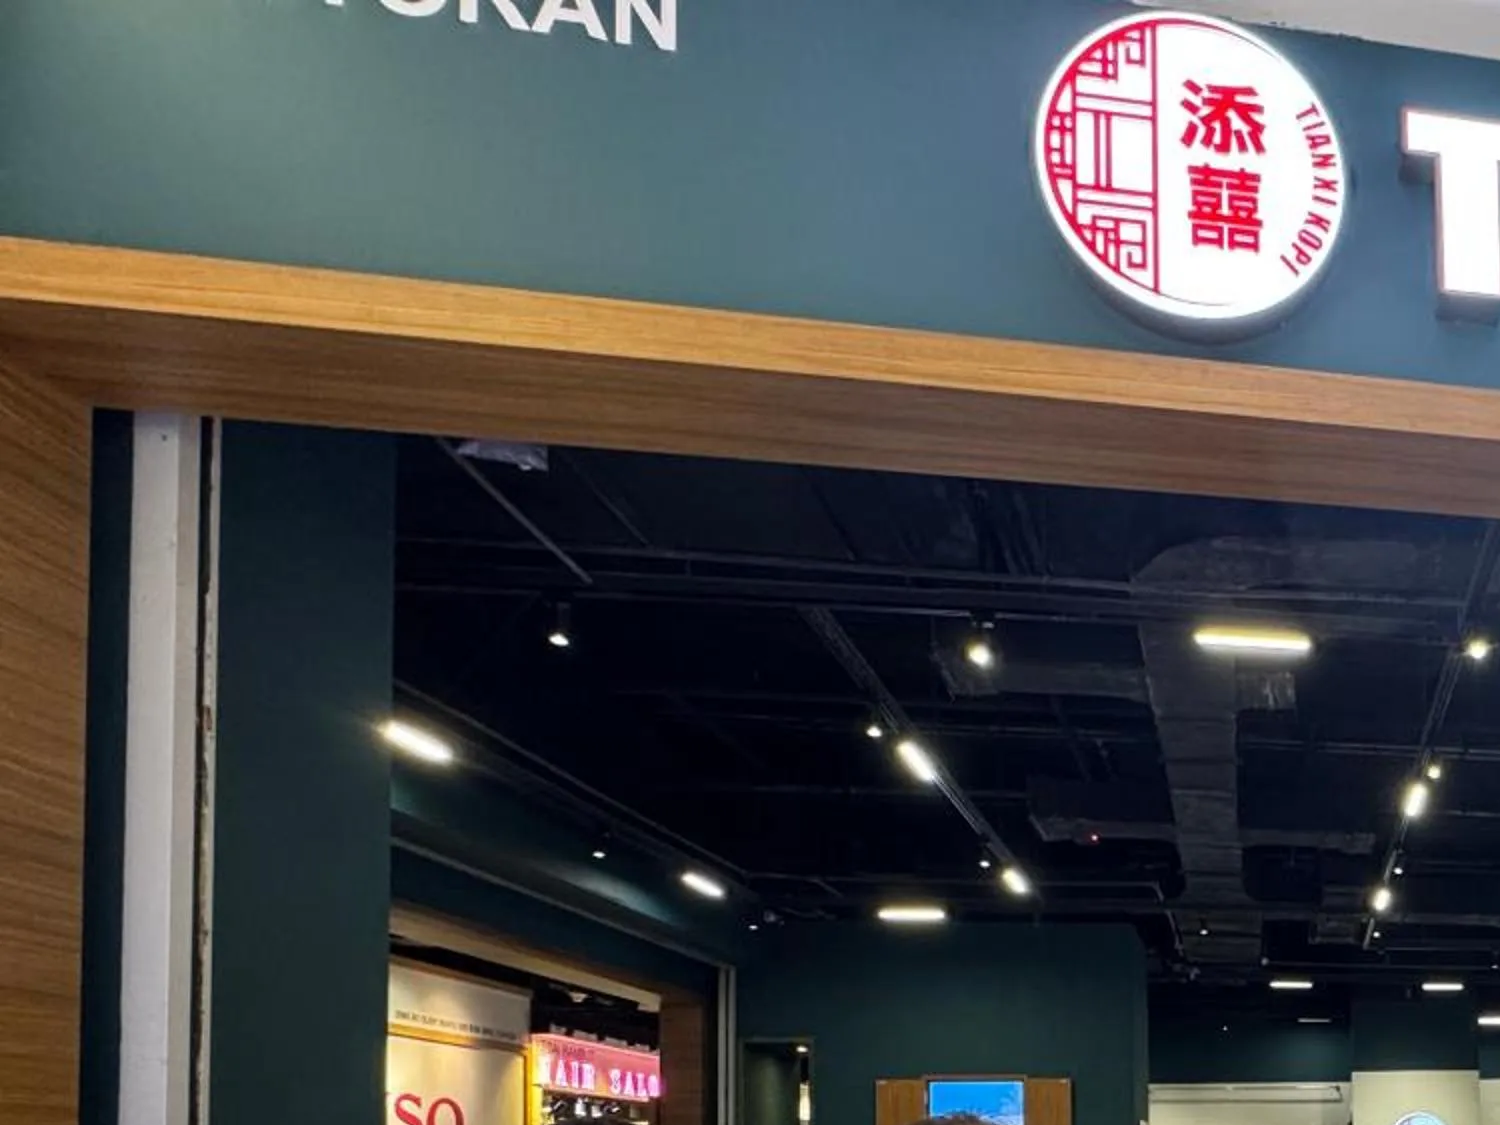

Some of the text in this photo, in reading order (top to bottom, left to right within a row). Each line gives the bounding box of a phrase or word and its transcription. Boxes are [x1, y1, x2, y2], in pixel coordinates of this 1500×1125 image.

[1279, 102, 1338, 277] TIAN XI KOPI
